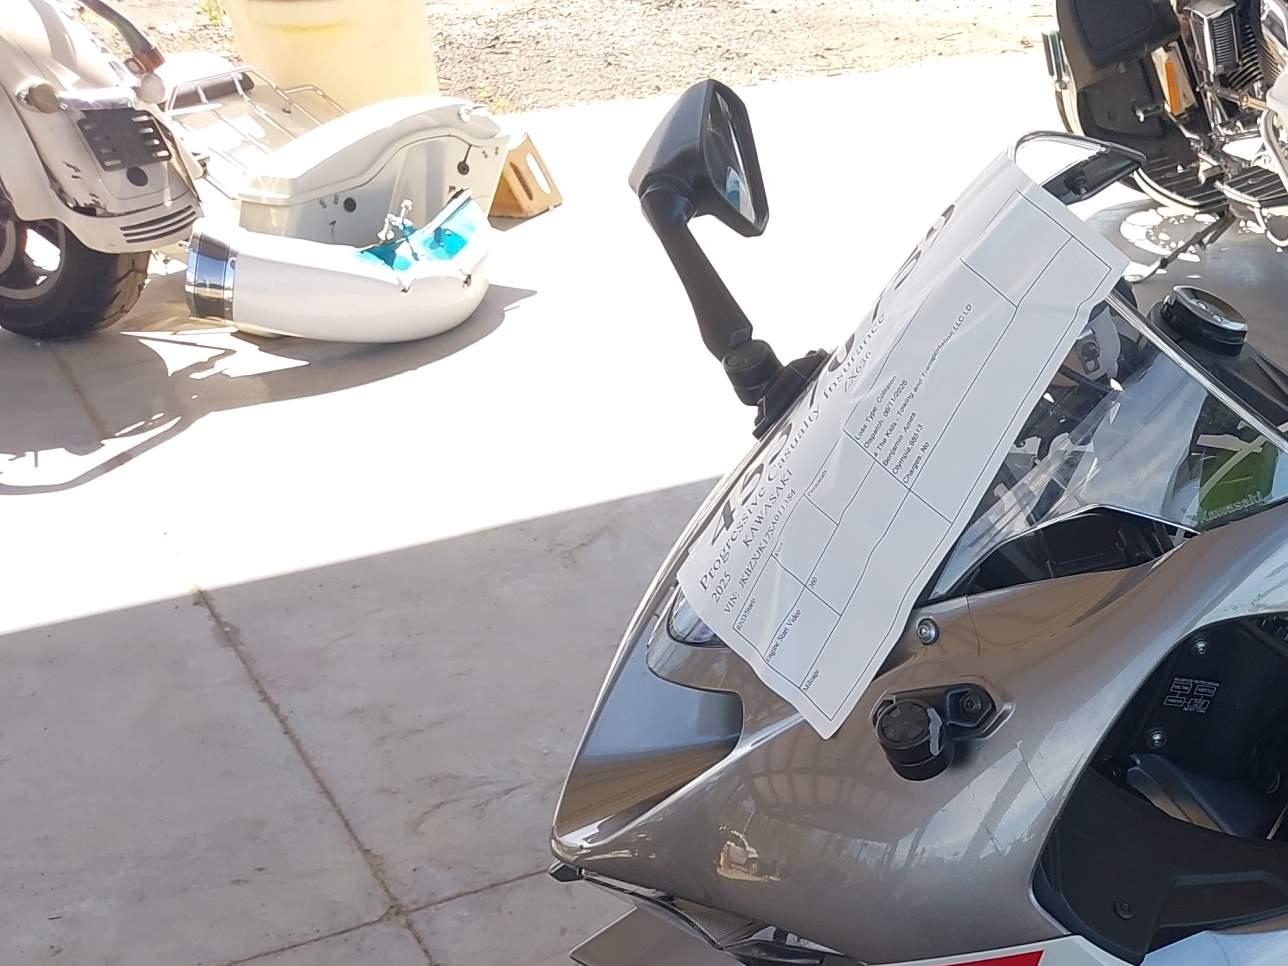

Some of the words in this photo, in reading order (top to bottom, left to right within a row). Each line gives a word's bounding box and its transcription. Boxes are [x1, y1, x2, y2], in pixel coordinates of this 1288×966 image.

[854, 423, 867, 441] Loss
[875, 374, 896, 404] Collision
[875, 436, 887, 451] The
[884, 420, 897, 437] Kids
[896, 392, 914, 416] Towing
[912, 378, 923, 392] and
[698, 485, 767, 591] Progressive
[767, 407, 818, 482] Casualty
[822, 313, 886, 399] Insurance
[882, 433, 904, 466] Benjamin
[919, 440, 929, 453] No
[710, 571, 731, 603] 2025
[742, 468, 792, 547] KAWASAKI
[723, 590, 740, 613] VIN:
[764, 639, 781, 663] Engine
[776, 624, 790, 642] Start
[785, 607, 802, 627] Video
